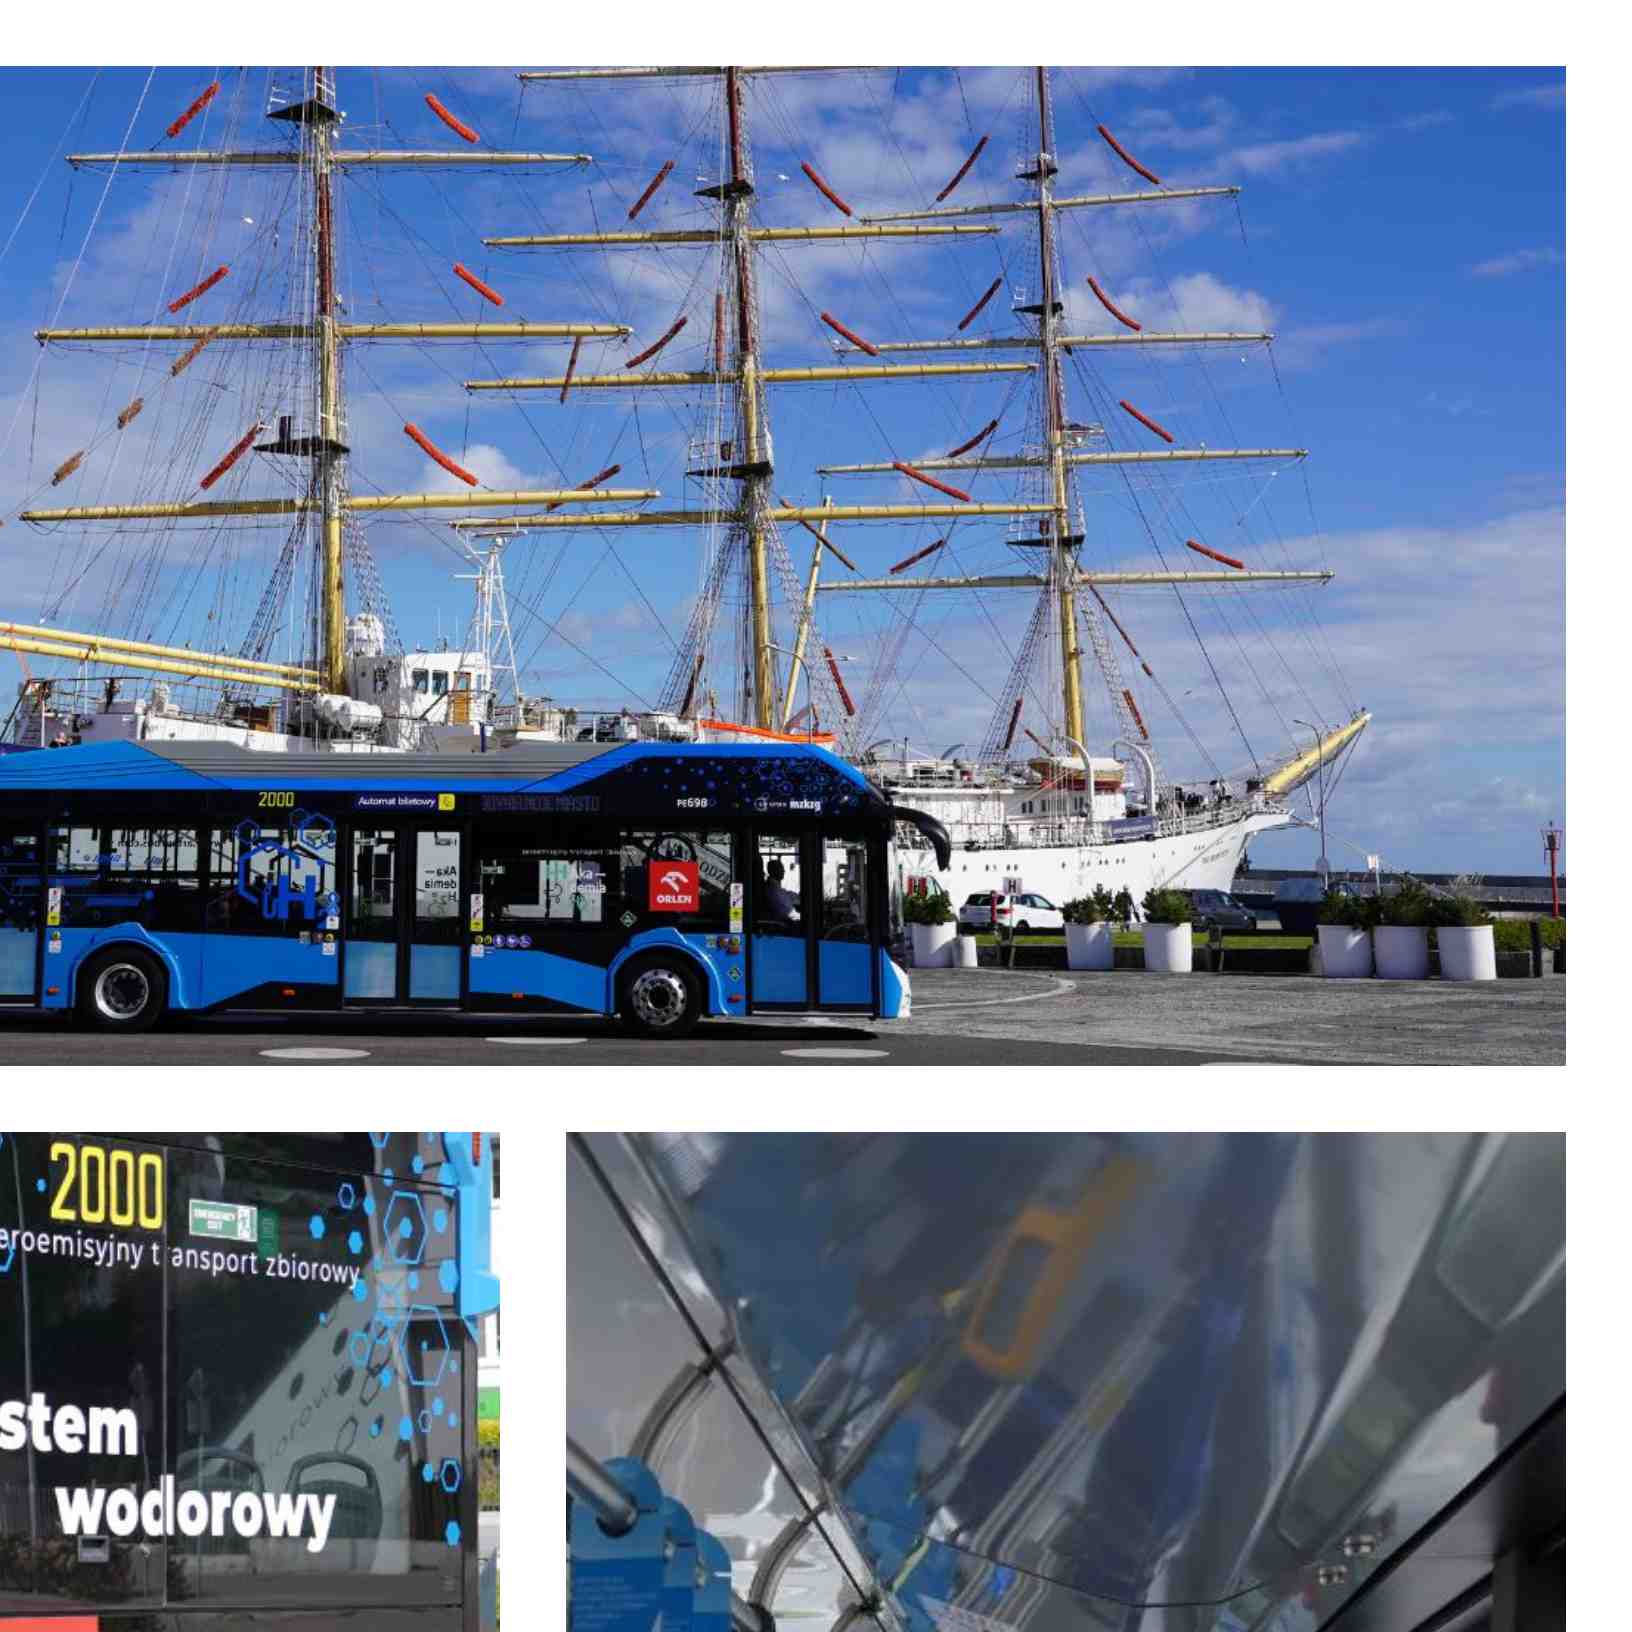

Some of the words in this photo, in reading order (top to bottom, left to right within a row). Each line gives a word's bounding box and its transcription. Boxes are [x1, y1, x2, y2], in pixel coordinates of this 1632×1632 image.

[258, 792, 295, 807] 2000
[358, 796, 396, 806] Automat
[677, 797, 709, 808] PE698
[656, 894, 692, 905] ORLEN
[50, 1142, 164, 1230] 2000
[152, 1241, 258, 1277] tansport
[265, 1256, 360, 1289] zbiorowy
[54, 1474, 338, 1554] wodorowy
